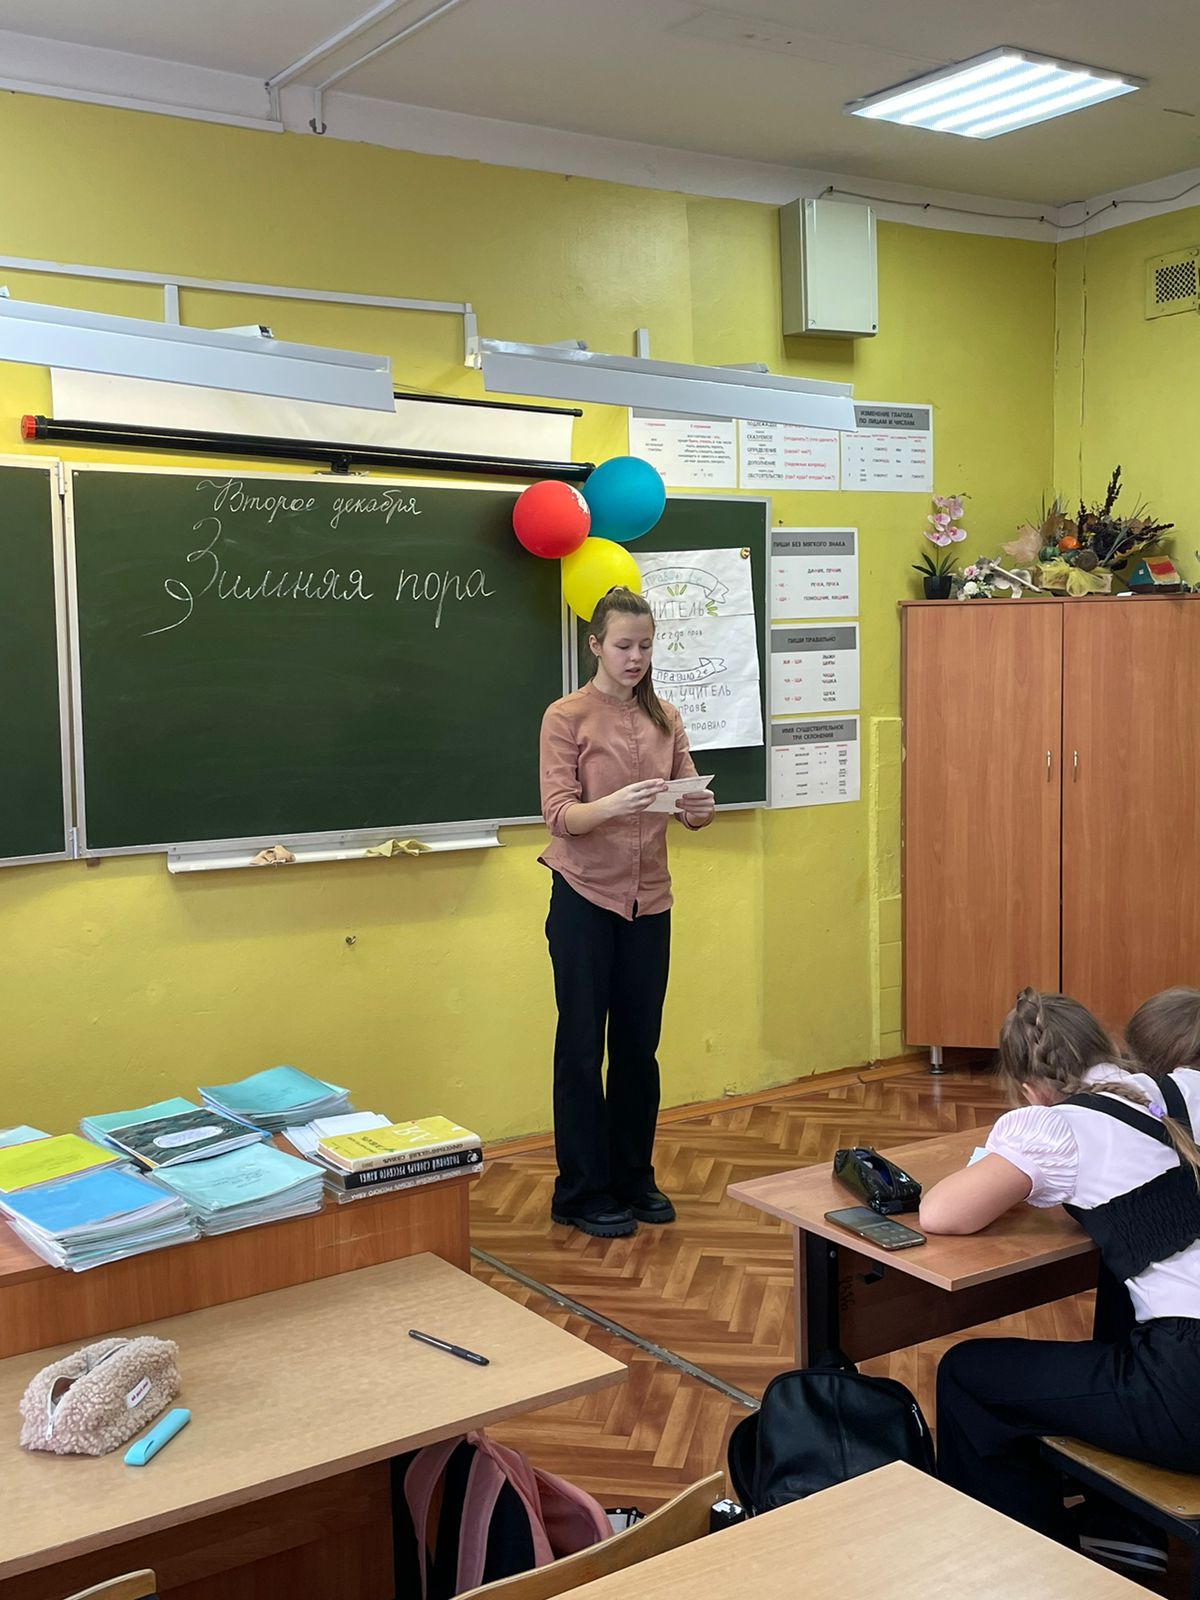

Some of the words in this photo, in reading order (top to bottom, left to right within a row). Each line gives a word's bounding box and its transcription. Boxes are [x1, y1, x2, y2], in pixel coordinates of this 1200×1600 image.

[860, 410, 890, 418] ИЗМЕНЕНИЕ
[891, 411, 913, 419] ГЛАГОЛА
[196, 479, 316, 525] Второе
[331, 489, 423, 529] декабря
[141, 516, 375, 637] Зимняя
[395, 568, 497, 629] пора
[650, 600, 705, 619] ЧИТЕЛЬ
[680, 685, 731, 702] УЧИТЕЛЬ
[796, 724, 844, 733] СУЩЕСТВИТЕЛЬНОЕ
[406, 1158, 431, 1172] СЛОВАРЬ
[433, 1154, 460, 1167] ТОЛКОВЫЙ
[359, 1170, 378, 1184] ЯЗЫКА
[379, 1164, 406, 1179] РУССКОГО
